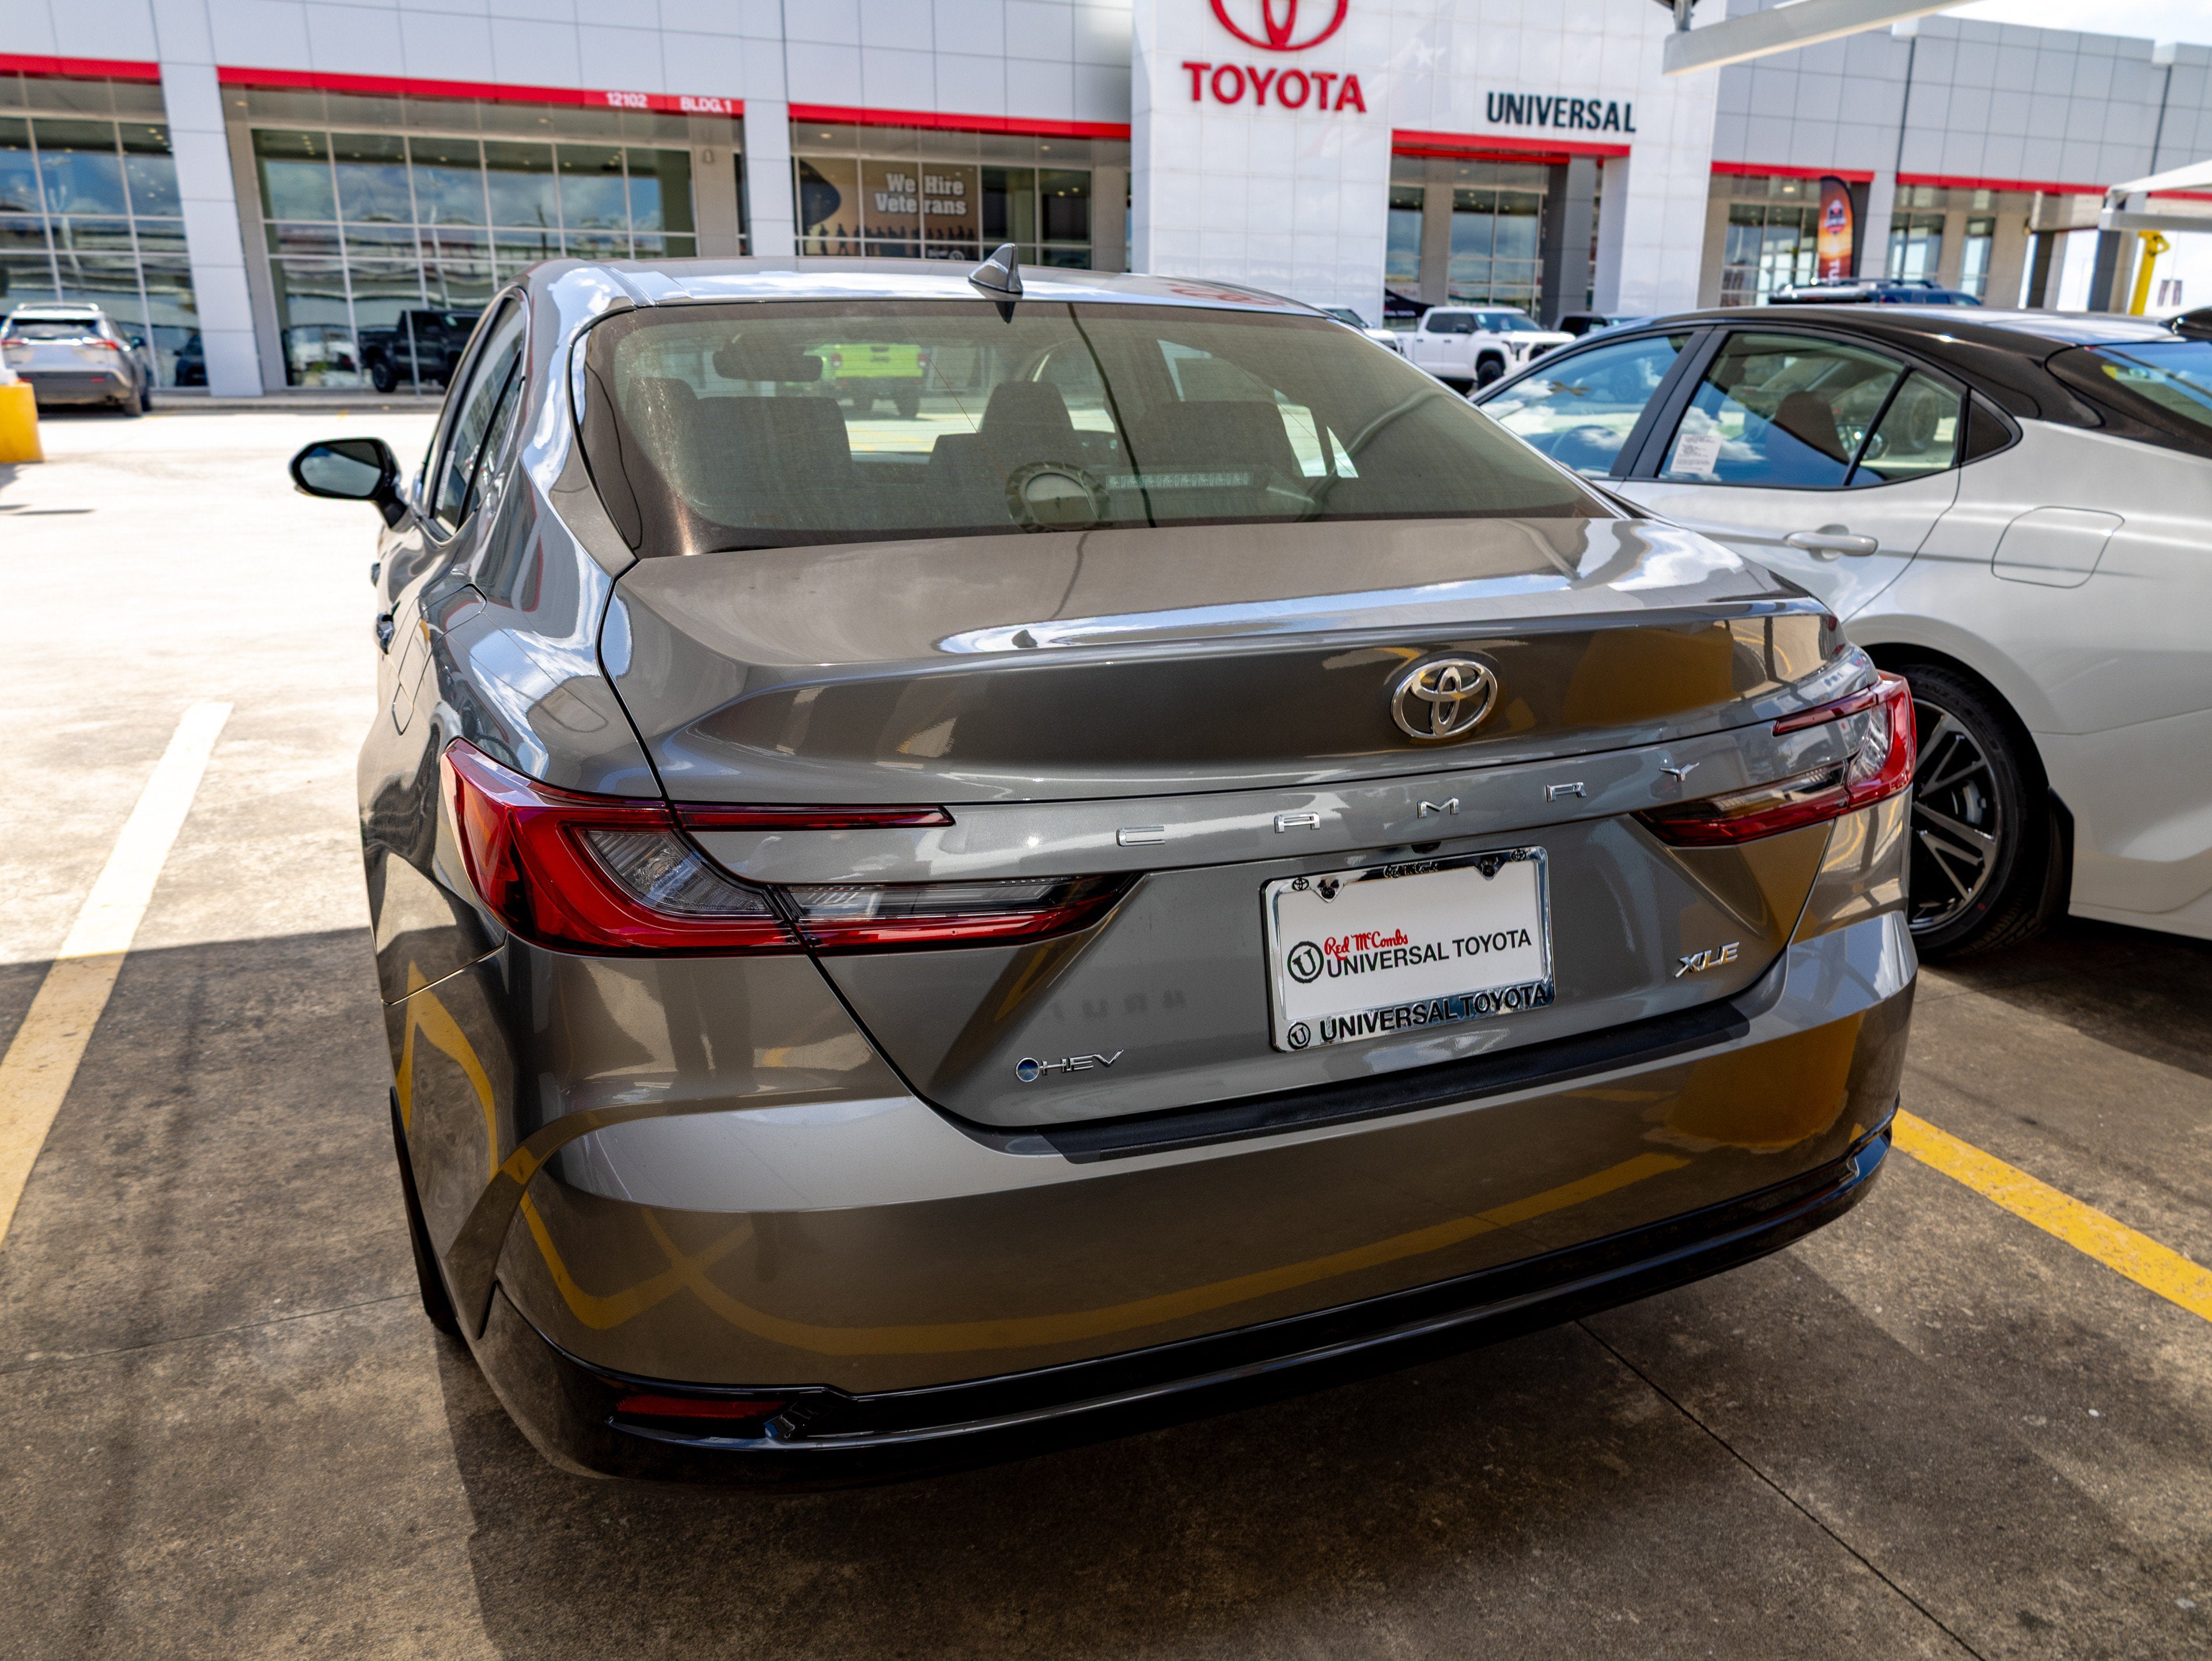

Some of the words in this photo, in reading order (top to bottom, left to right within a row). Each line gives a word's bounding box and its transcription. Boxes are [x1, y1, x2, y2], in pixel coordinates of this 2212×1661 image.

[607, 92, 647, 108] 12102
[724, 99, 732, 113] 1
[1182, 61, 1367, 113] TOYOTA
[1487, 92, 1637, 133] UNIVERSAL
[874, 192, 967, 215] Veterans
[886, 173, 916, 194] We
[924, 175, 964, 196] Hire
[1116, 762, 1699, 846] CAMRY
[1324, 937, 1350, 960] Red
[1351, 928, 1408, 951] McCombs
[1327, 942, 1449, 978] UNIVERSAL
[1452, 929, 1532, 958] TOYOTA
[1675, 941, 1740, 978] XLE
[1320, 1000, 1458, 1041] UNIVERSAL
[1460, 982, 1548, 1016] TOYOTA
